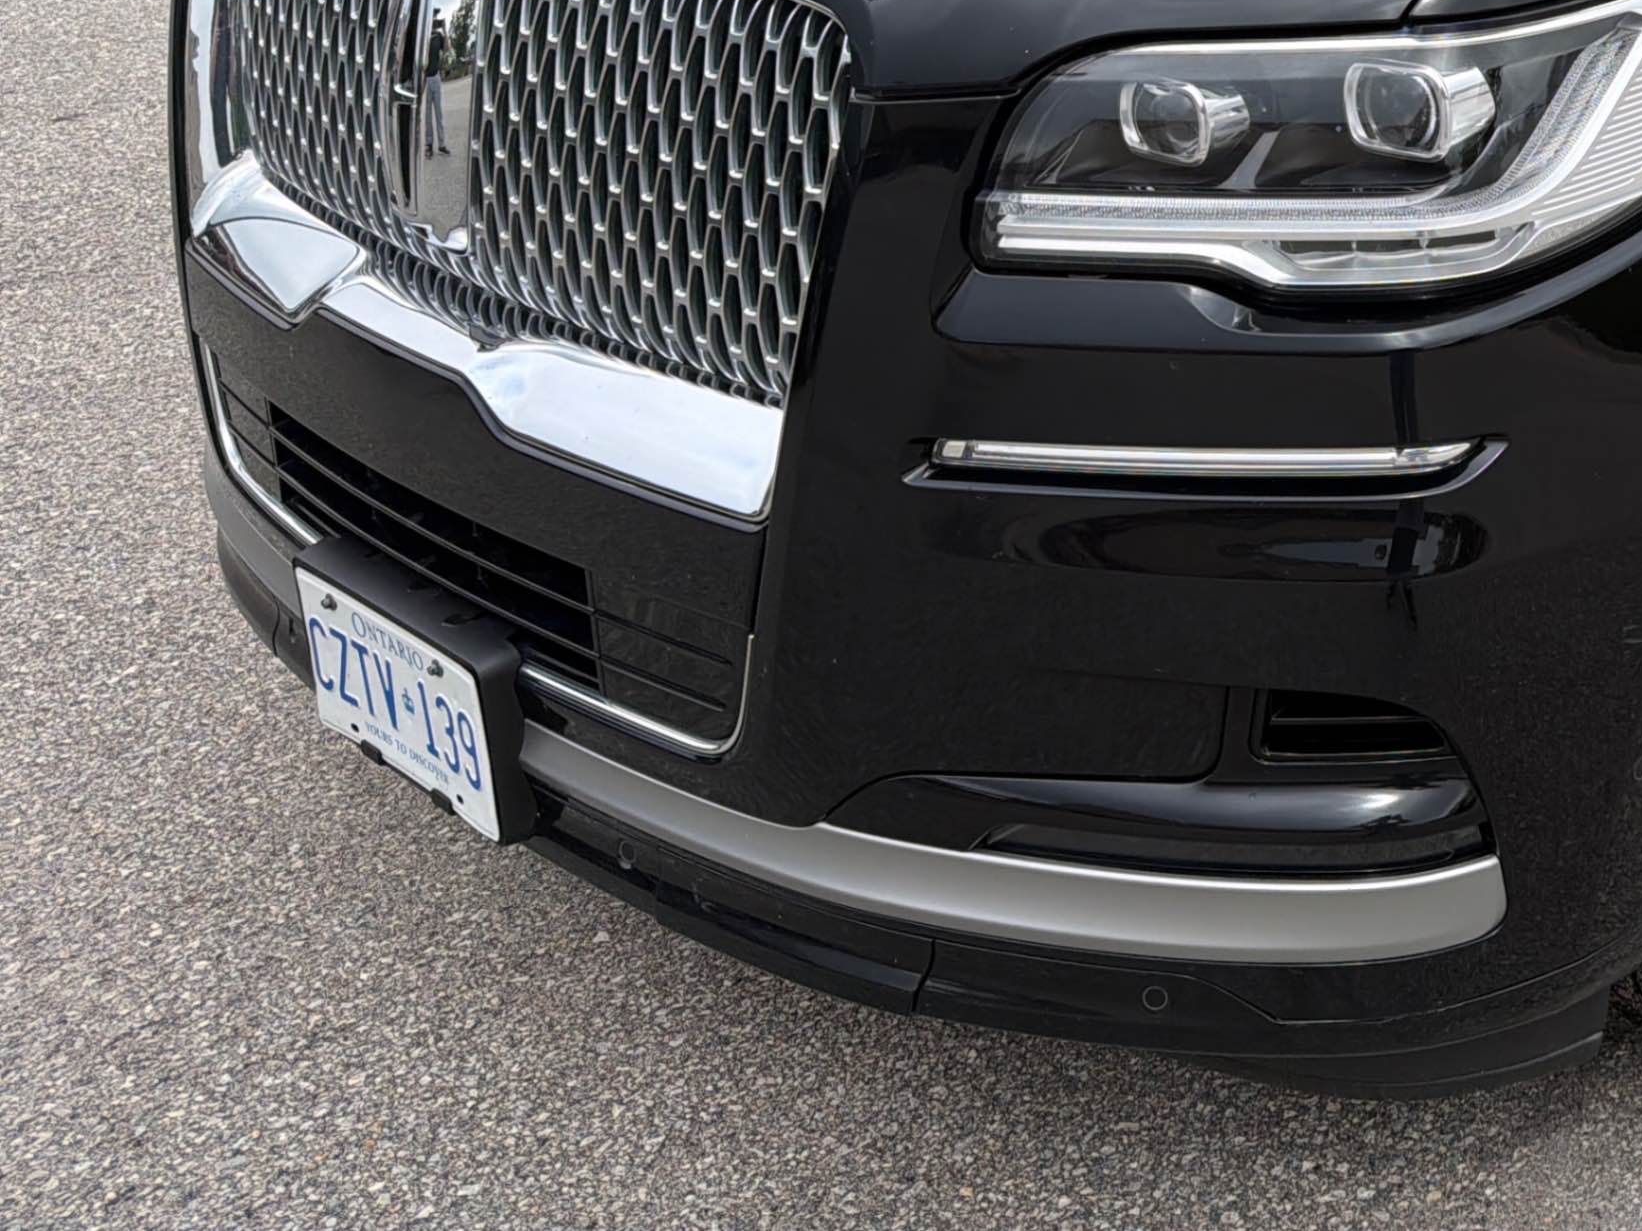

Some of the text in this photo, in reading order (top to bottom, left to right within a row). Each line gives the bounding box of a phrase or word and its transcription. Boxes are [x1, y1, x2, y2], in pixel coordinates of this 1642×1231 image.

[351, 611, 424, 671] ONTARIO
[394, 738, 407, 755] TO
[417, 680, 481, 791] 139
